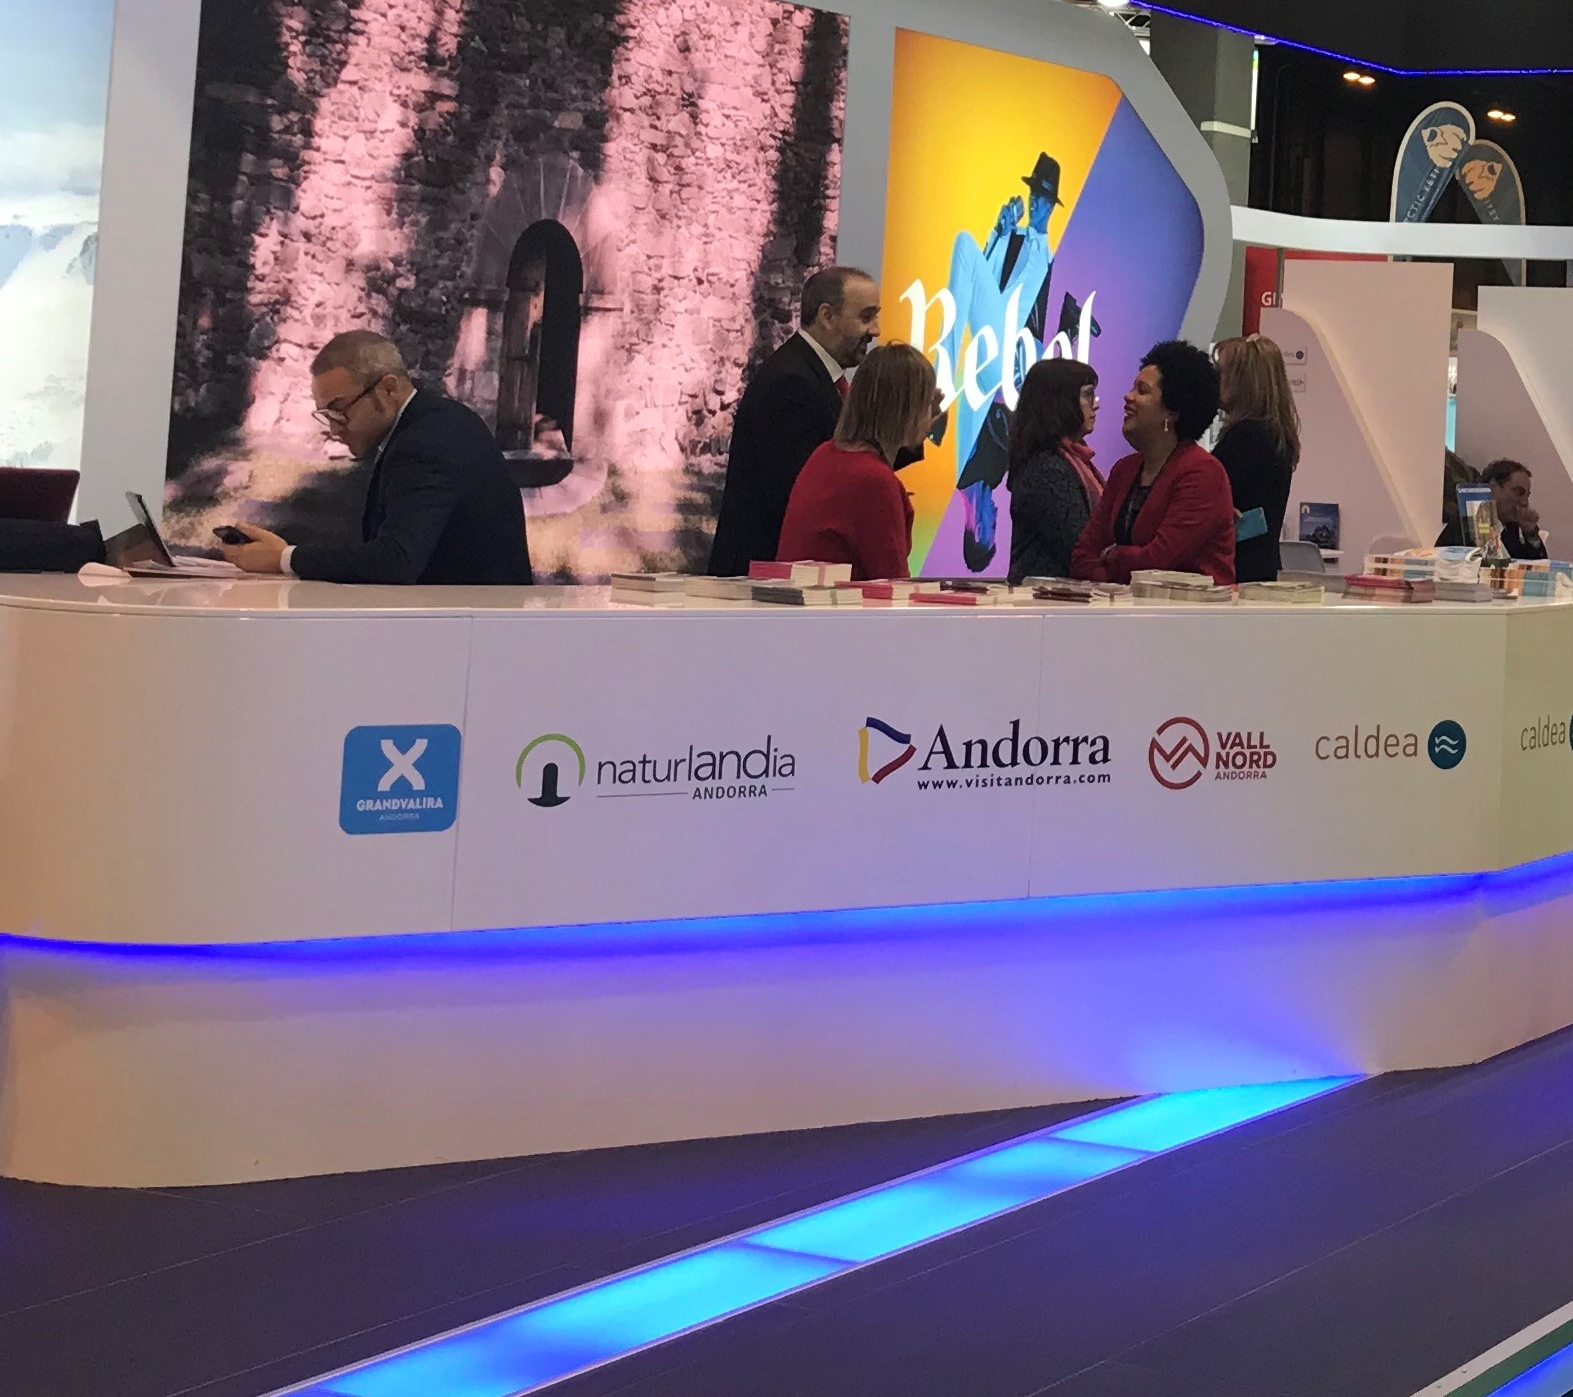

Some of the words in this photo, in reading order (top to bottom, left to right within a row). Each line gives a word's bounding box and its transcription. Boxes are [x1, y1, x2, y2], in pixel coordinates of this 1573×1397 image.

[1216, 730, 1271, 750] VALL
[1520, 714, 1566, 751] caldea
[917, 718, 1111, 771] Andorra
[1314, 724, 1419, 762] caldea
[597, 734, 796, 787] naturlandia
[1215, 749, 1277, 770] NORD
[916, 771, 1112, 791] www.visitandorra.com
[1214, 770, 1268, 781] ANDORRA
[692, 783, 769, 801] ANDORRA
[356, 796, 444, 812] GRANDVALIRA
